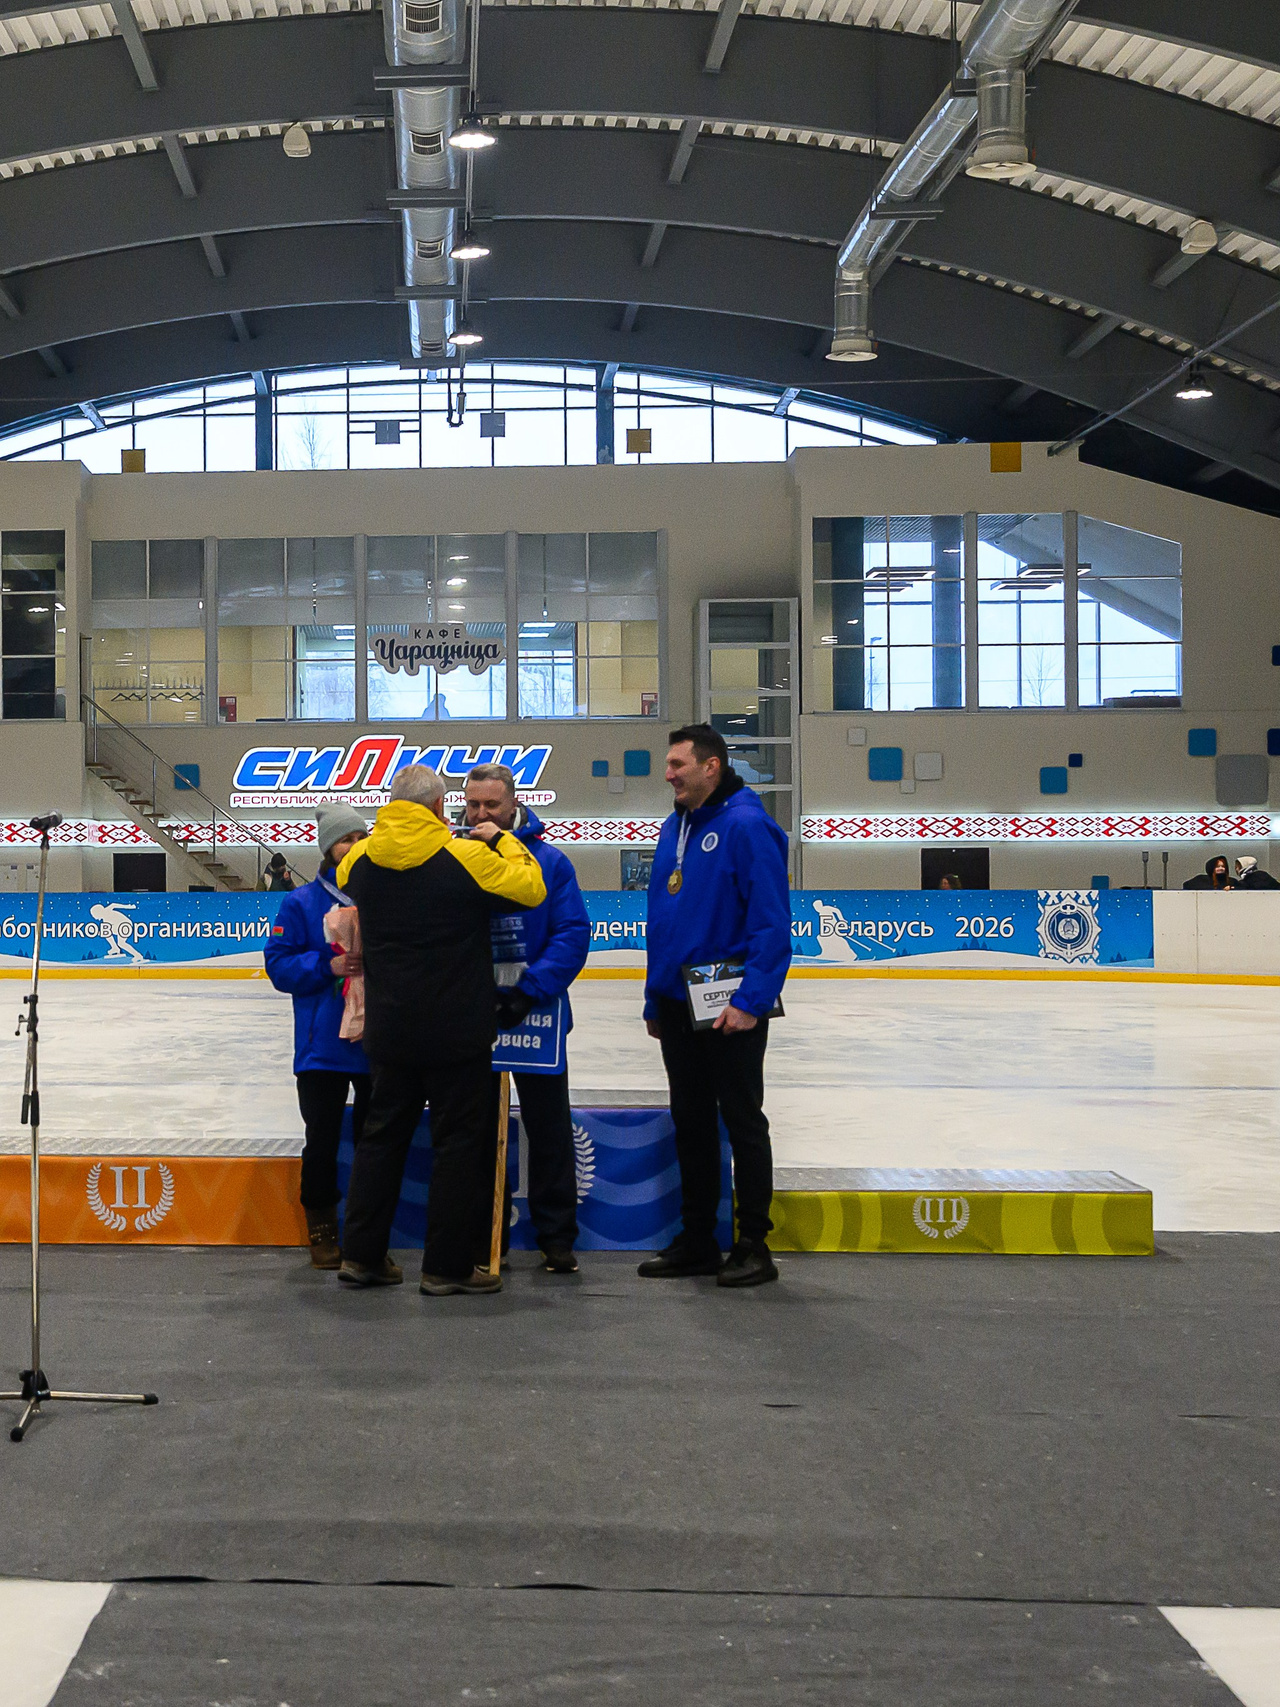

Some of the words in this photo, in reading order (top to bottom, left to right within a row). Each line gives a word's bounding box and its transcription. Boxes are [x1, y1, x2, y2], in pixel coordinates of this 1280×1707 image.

[414, 628, 461, 639] КАФЕ
[517, 793, 553, 803] ЕНТР
[117, 916, 271, 943] организаций
[819, 915, 935, 943] Беларусь
[954, 915, 1016, 940] 2026
[109, 1165, 151, 1208] II
[921, 1198, 963, 1224] III
